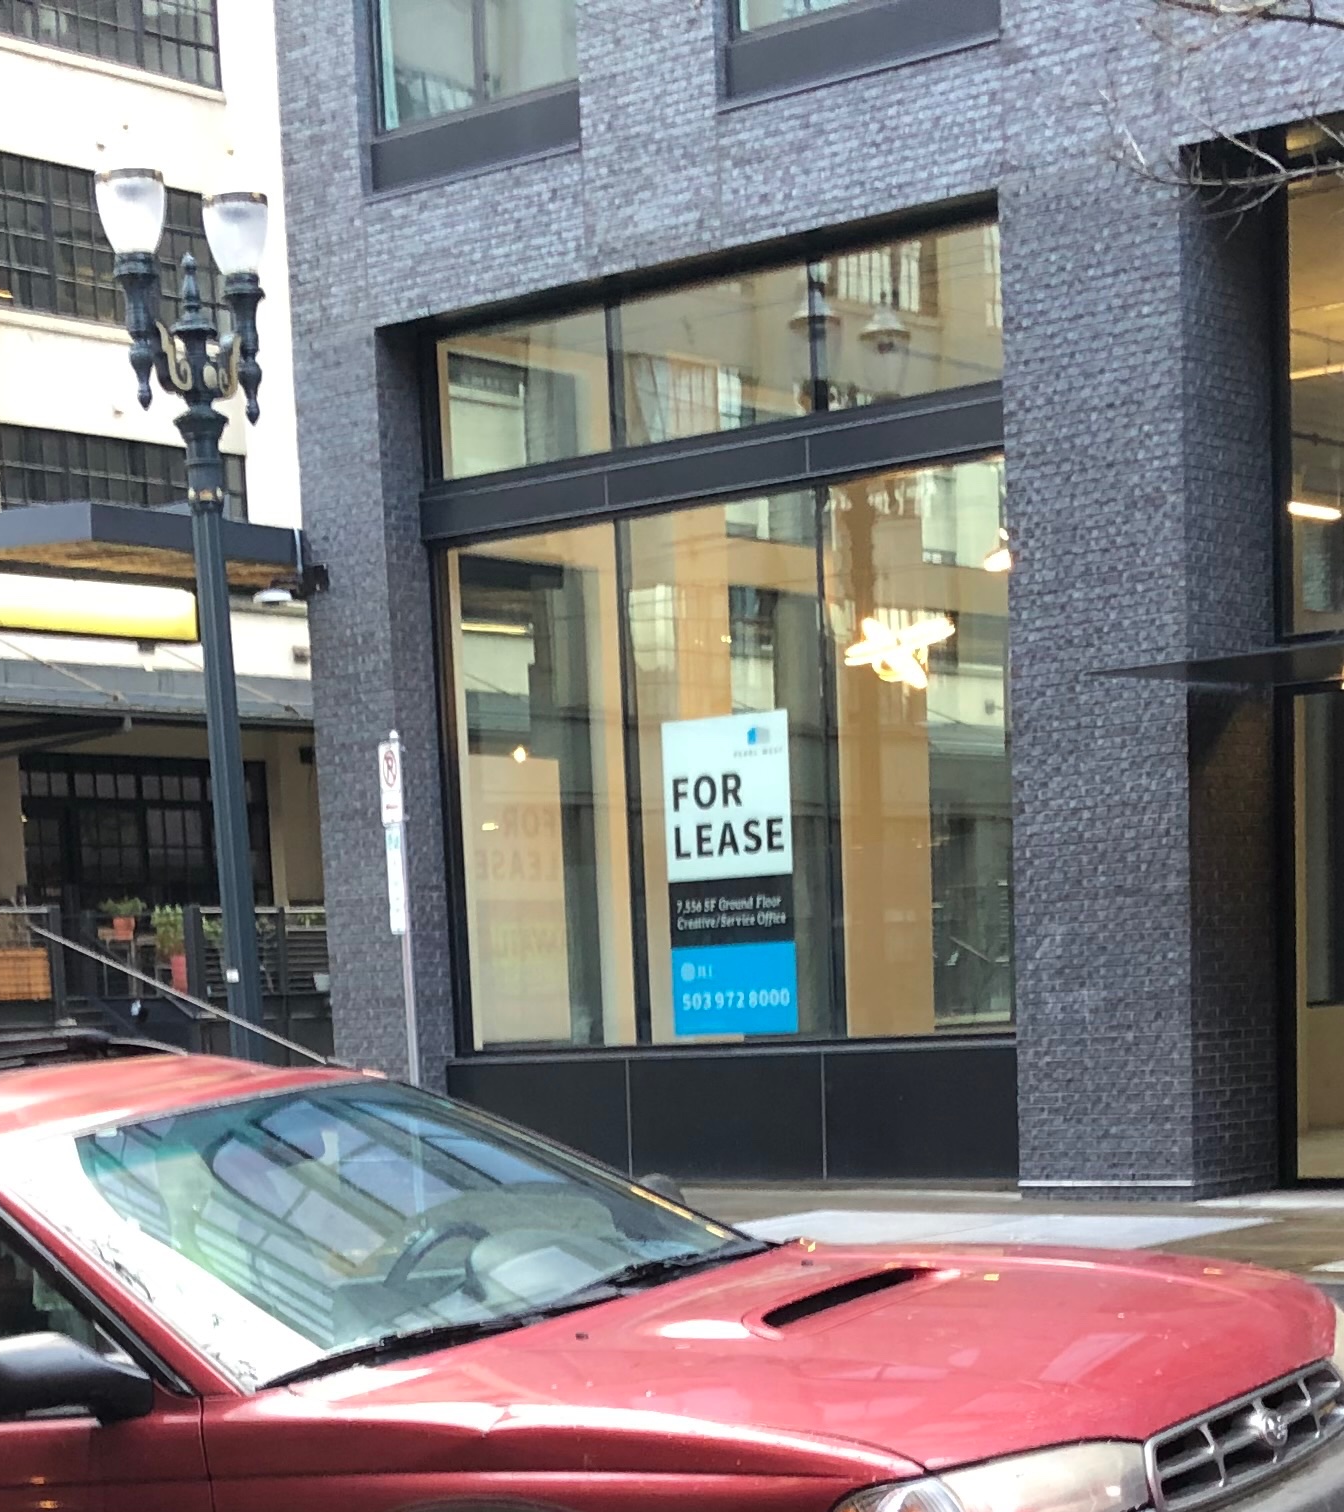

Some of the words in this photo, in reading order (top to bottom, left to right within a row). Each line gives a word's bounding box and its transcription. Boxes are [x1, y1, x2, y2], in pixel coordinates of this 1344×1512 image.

[672, 772, 742, 812] FOR
[674, 817, 784, 860] LEASE
[704, 899, 716, 912] SF
[718, 896, 754, 911] Ground
[756, 894, 782, 908] Floor
[757, 911, 786, 927] Office
[682, 992, 712, 1011] 503
[715, 991, 745, 1009] 972
[749, 988, 790, 1008] 8000
